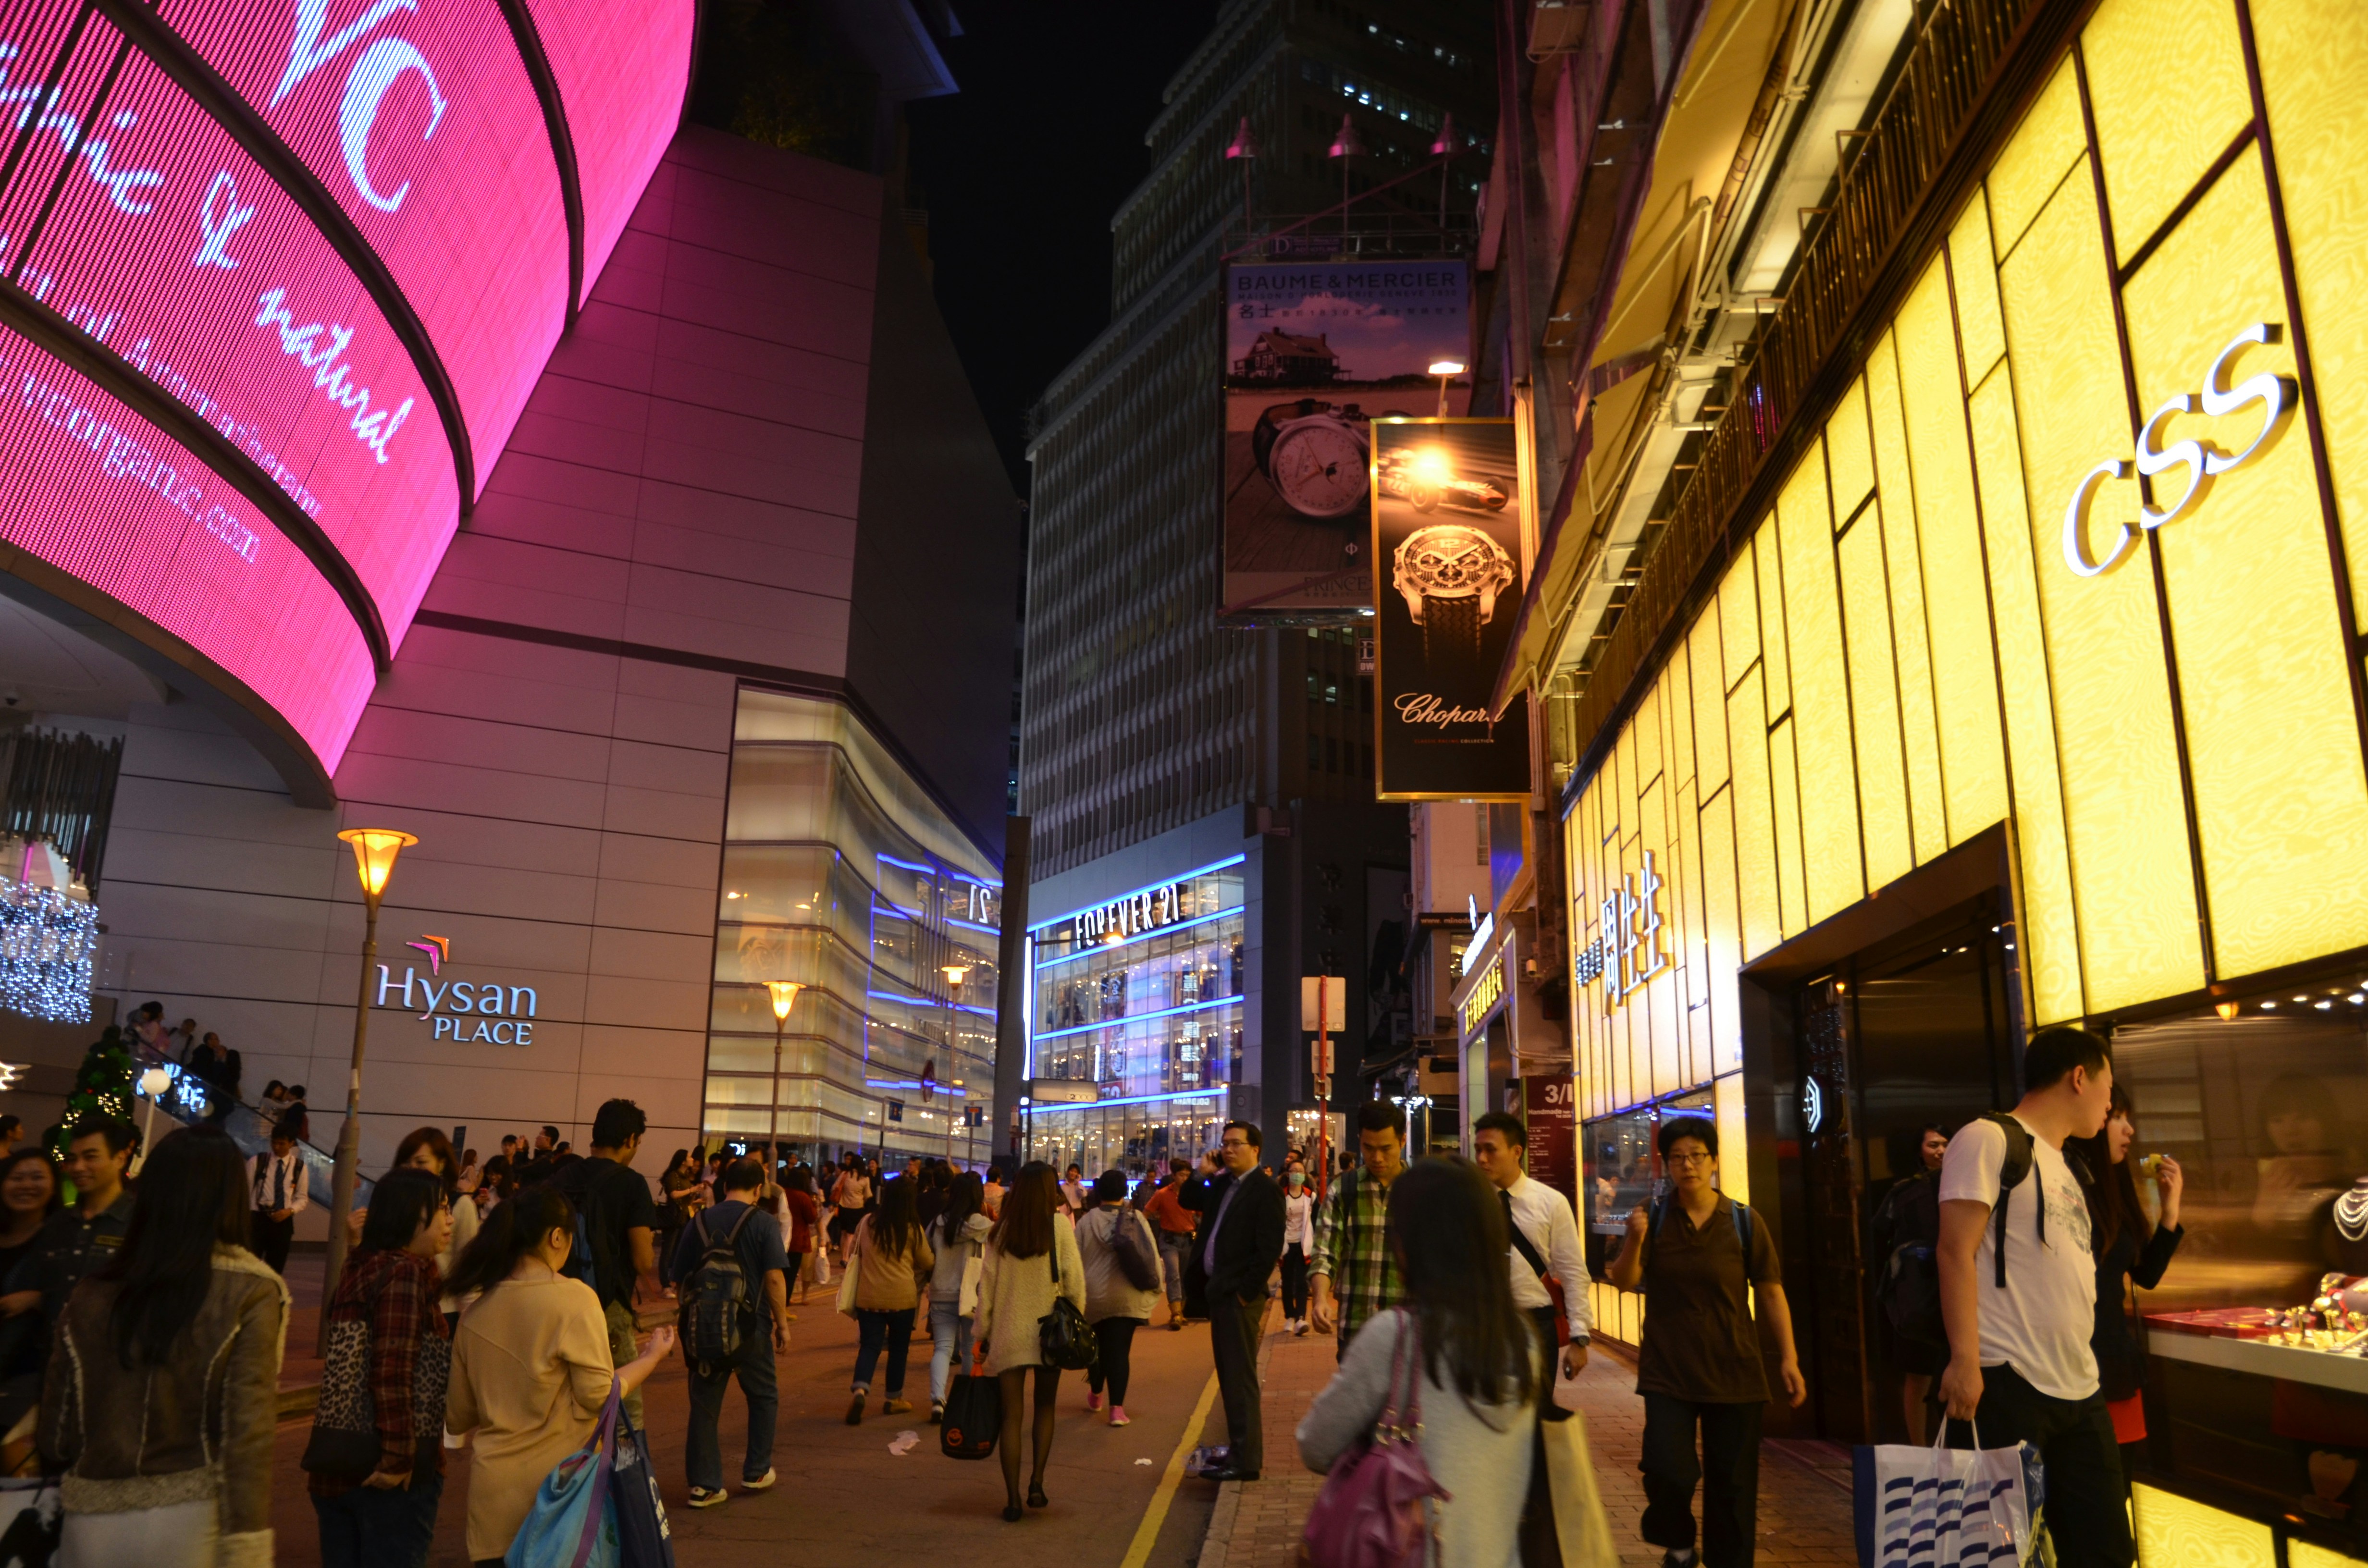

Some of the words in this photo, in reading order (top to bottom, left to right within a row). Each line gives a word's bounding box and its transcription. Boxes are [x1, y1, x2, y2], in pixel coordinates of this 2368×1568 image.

[1238, 275, 1322, 290] BAUME
[1328, 274, 1341, 288] &
[1347, 272, 1455, 288] MERCIER
[1239, 304, 1275, 319] 名士
[256, 287, 414, 464] natural
[1075, 892, 1153, 950] FOREVER
[1159, 883, 1179, 925] 21
[376, 964, 537, 1020] Hysan
[434, 1017, 533, 1046] PLACE
